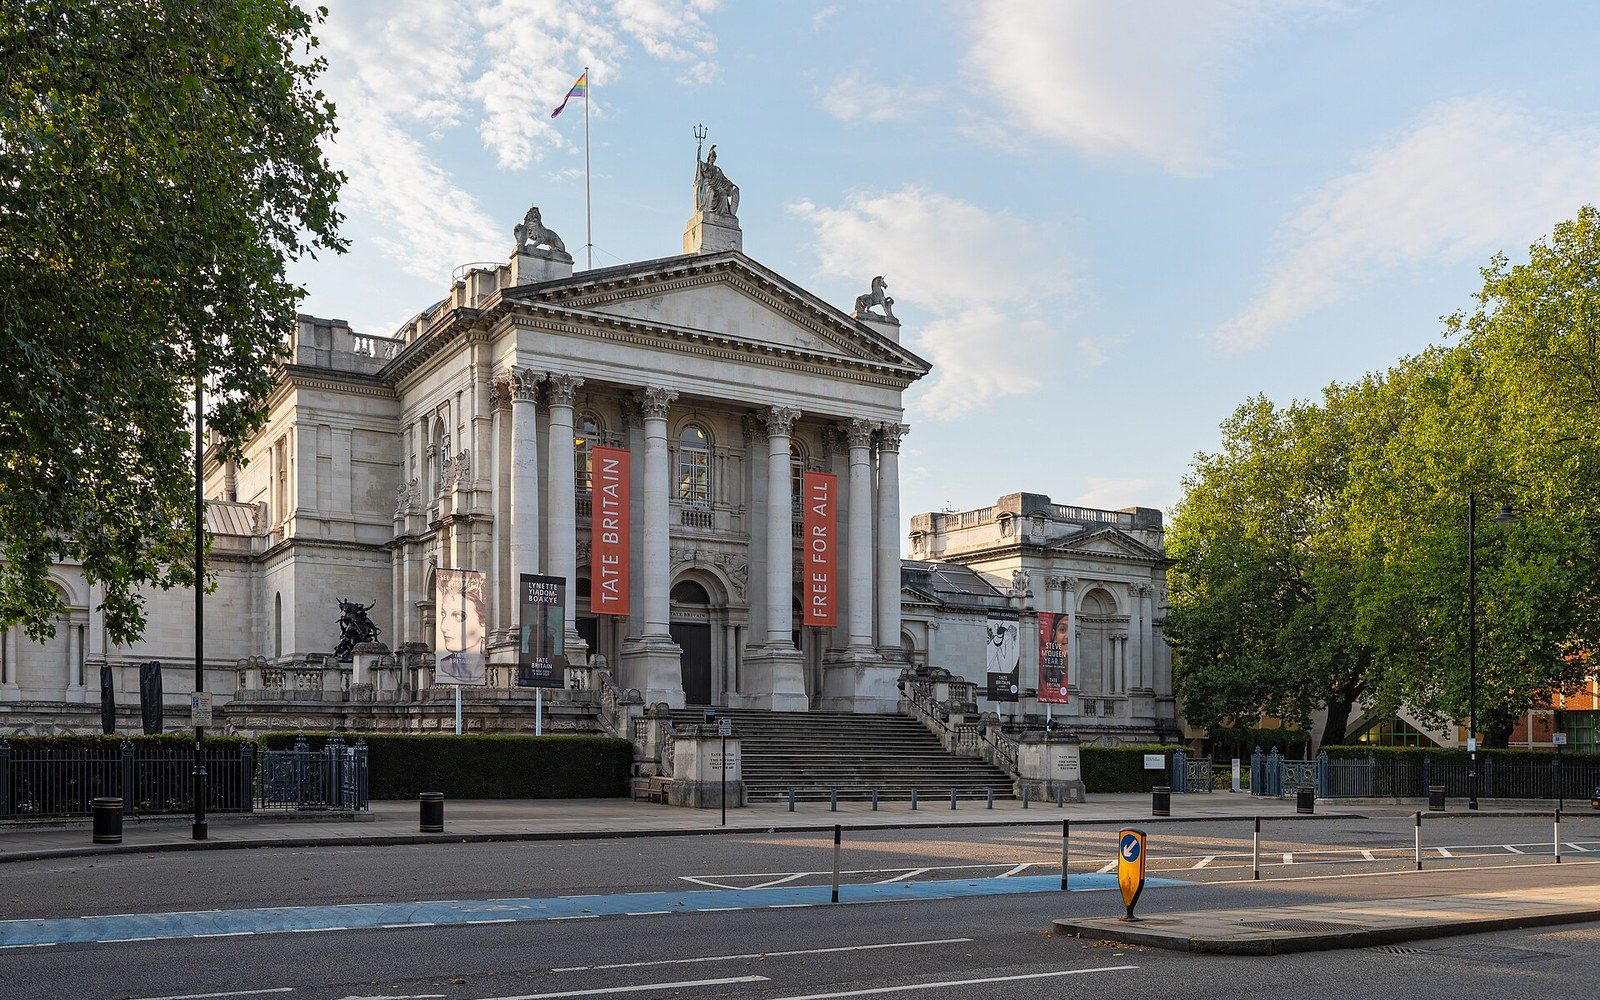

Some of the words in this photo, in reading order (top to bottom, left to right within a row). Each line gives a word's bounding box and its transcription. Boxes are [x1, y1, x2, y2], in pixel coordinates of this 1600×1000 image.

[602, 458, 619, 544] BRITAIN
[813, 482, 827, 517] ALL
[813, 525, 827, 563] FOR
[528, 582, 557, 590] LYNETTE
[602, 554, 619, 603] TATE
[528, 589, 557, 597] YIADOM-
[528, 596, 557, 604] BOAKYE
[813, 573, 827, 617] FREE
[1045, 642, 1062, 650] STEVE
[1044, 656, 1058, 665] YEAR
